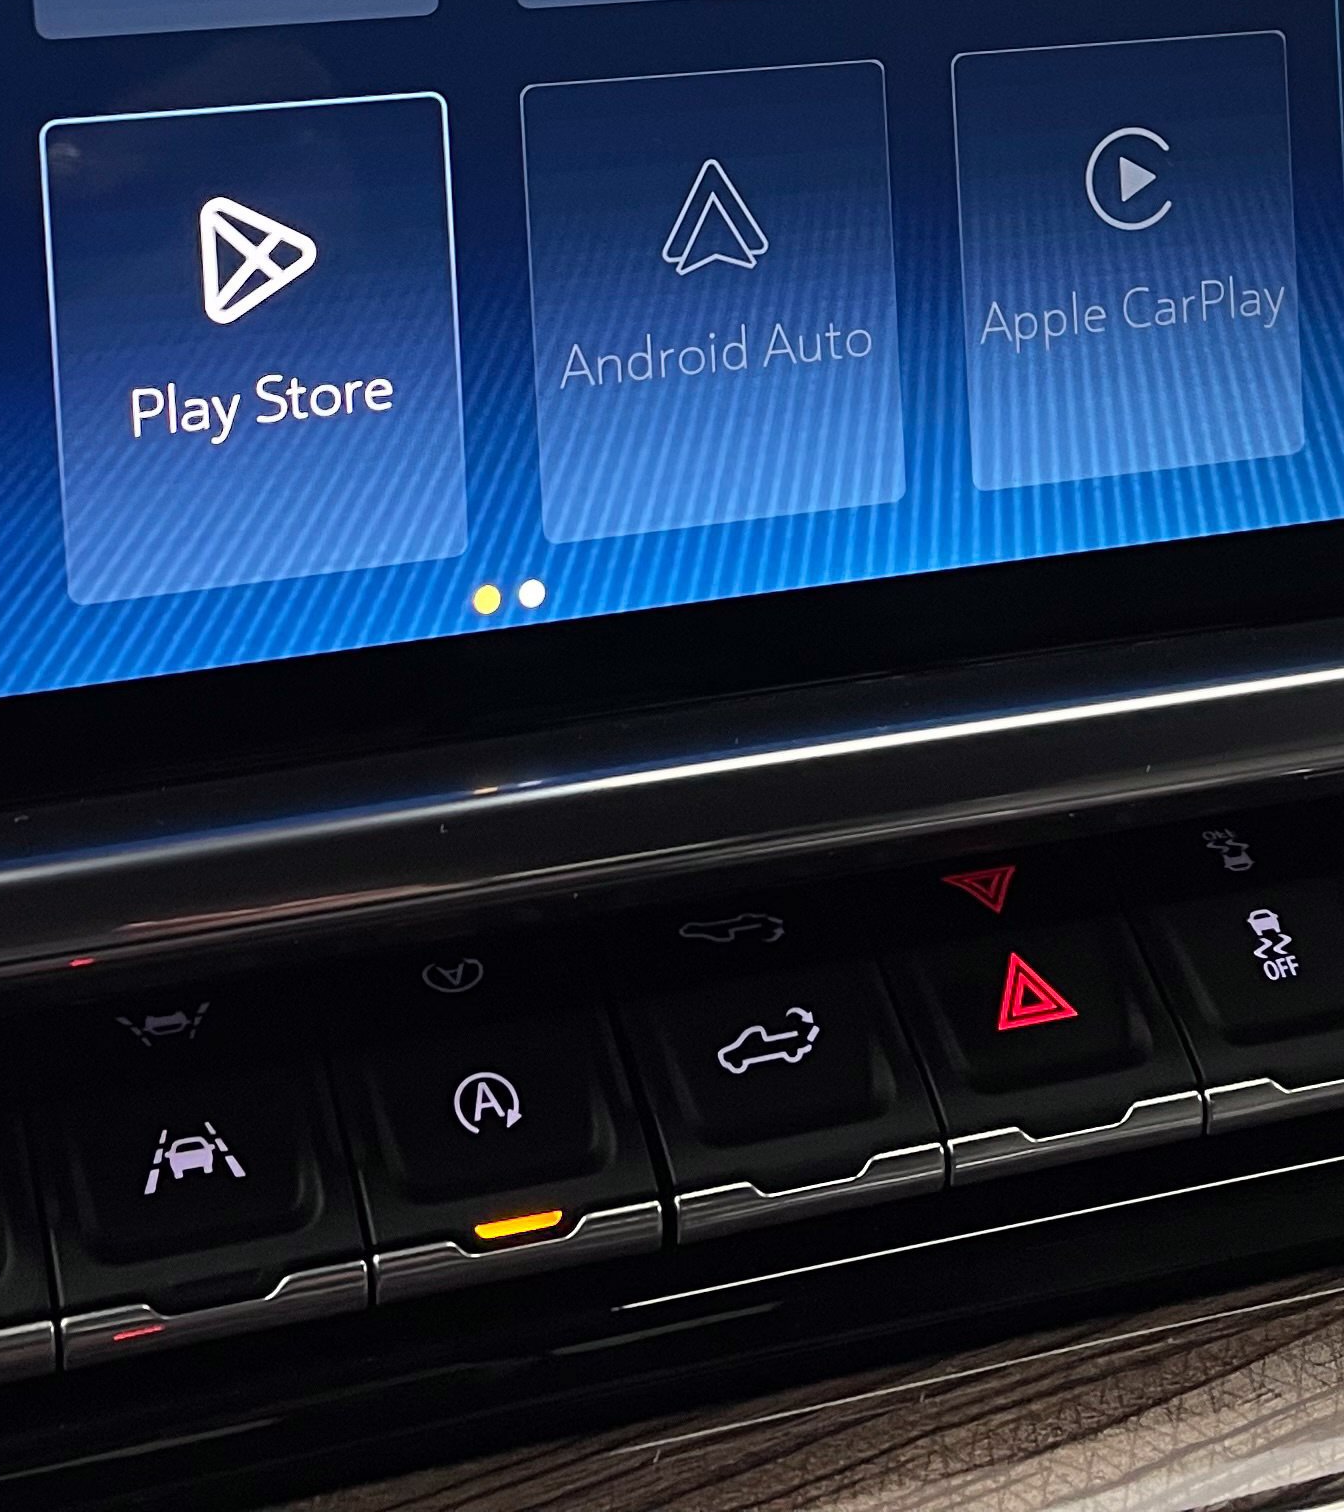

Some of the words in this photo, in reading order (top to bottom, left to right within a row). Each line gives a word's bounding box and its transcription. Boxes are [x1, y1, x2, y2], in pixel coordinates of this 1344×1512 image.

[979, 289, 1108, 355] Apple
[1122, 274, 1286, 330] CarPlay
[559, 322, 750, 390] Android
[762, 321, 873, 369] Auto
[130, 381, 242, 446] Play
[254, 373, 395, 425] Store
[1262, 954, 1300, 982] OFF
[473, 1080, 506, 1122] A
